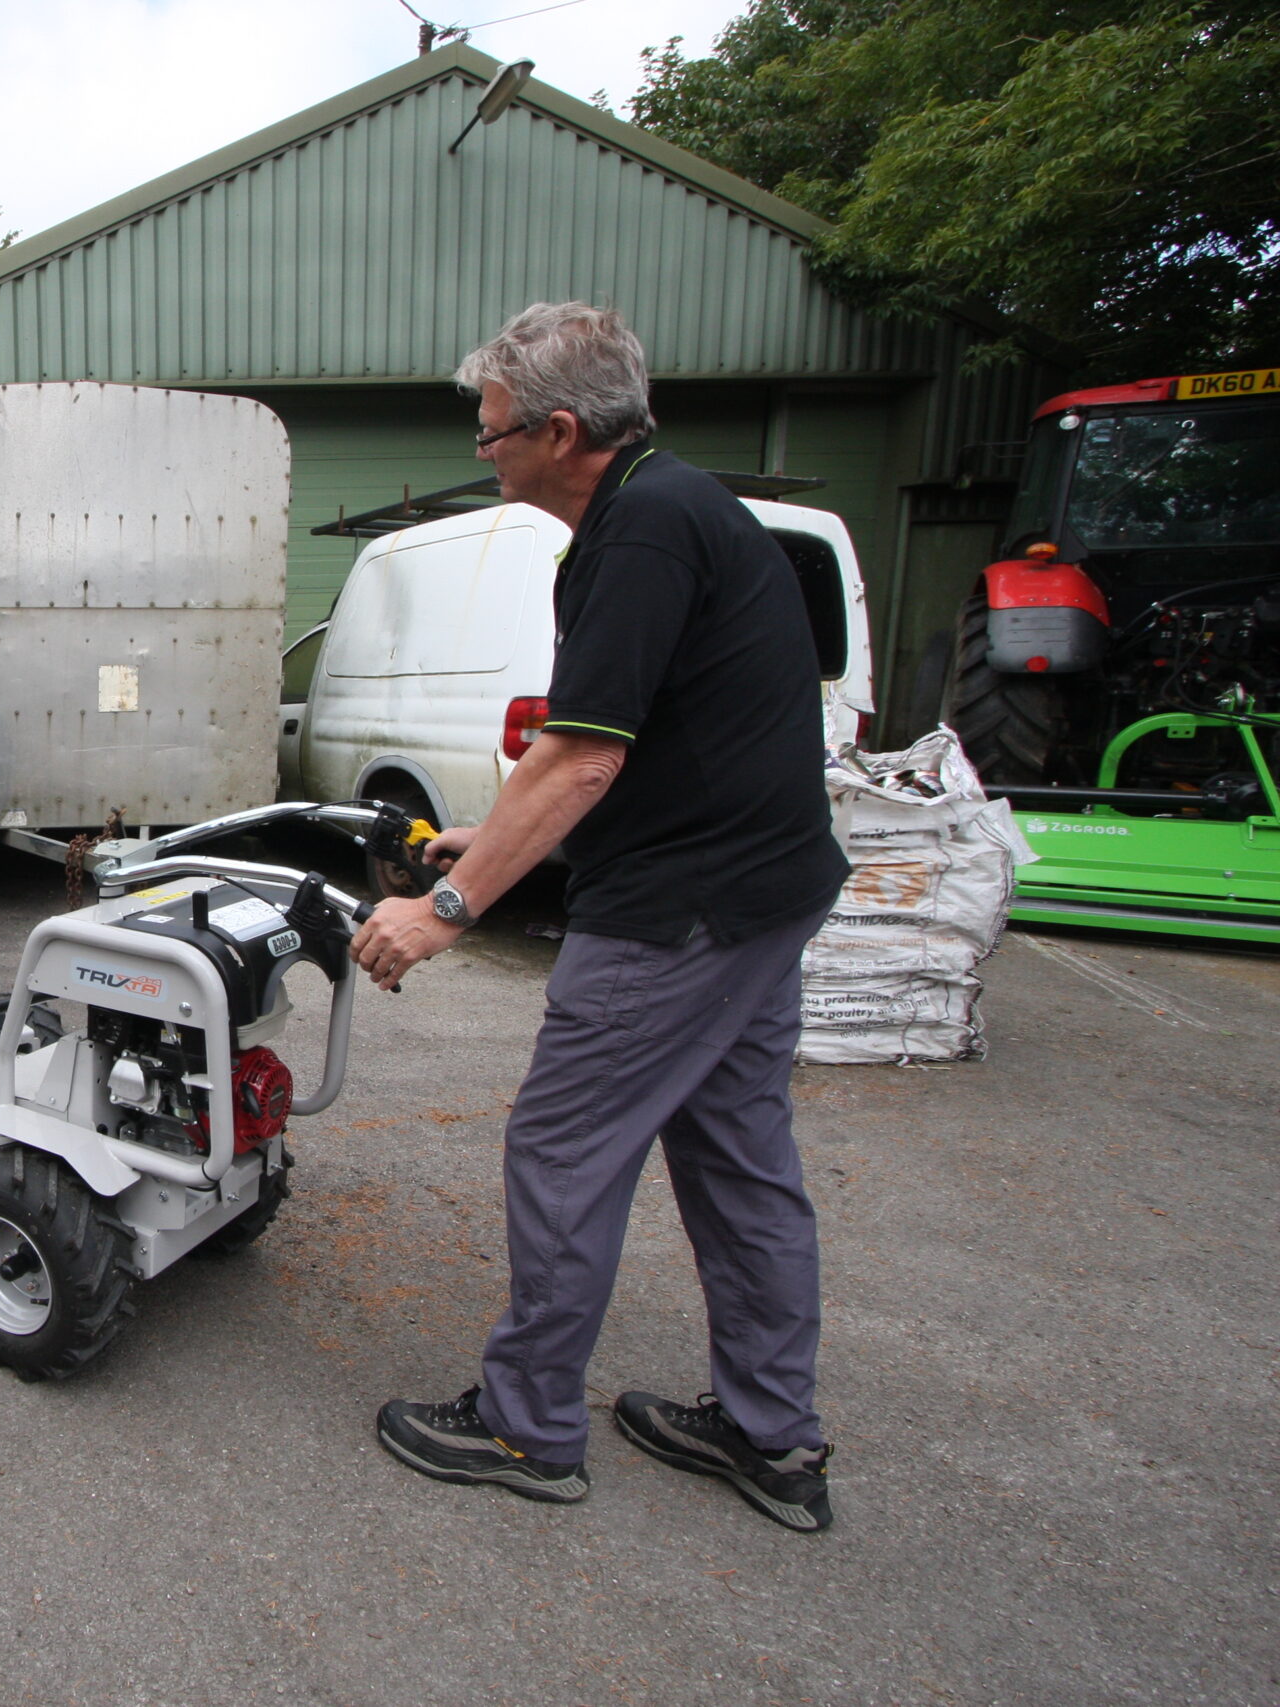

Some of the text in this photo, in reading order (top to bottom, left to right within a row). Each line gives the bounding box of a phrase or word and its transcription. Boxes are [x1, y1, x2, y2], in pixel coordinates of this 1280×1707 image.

[1190, 371, 1280, 395] DK60 A
[824, 993, 891, 1006] protection
[828, 1007, 874, 1019] poultry
